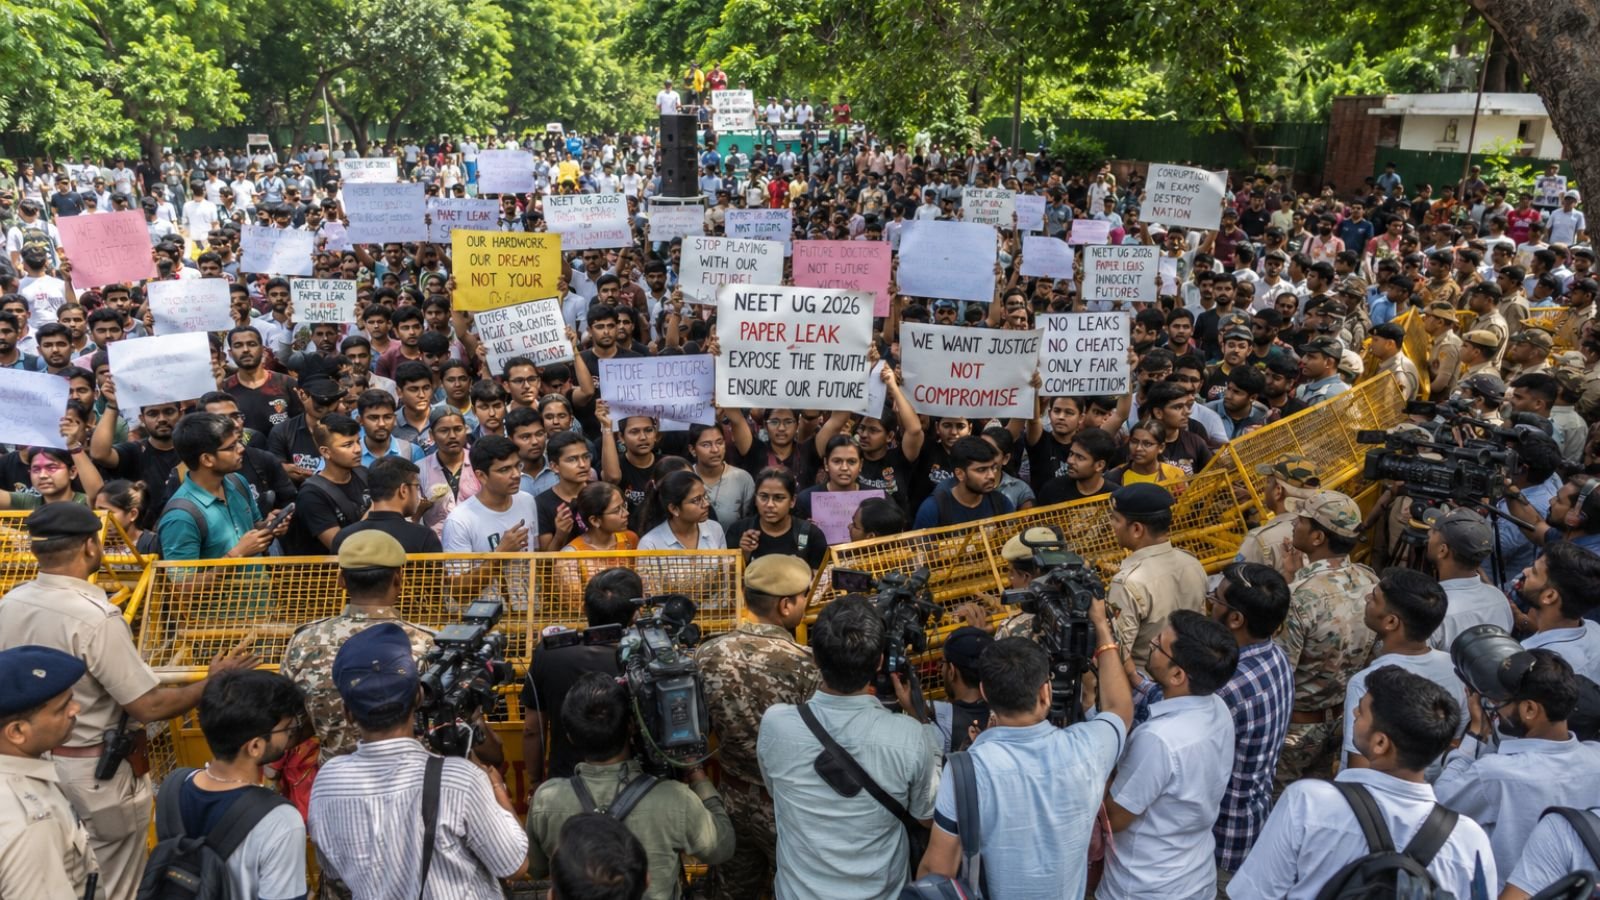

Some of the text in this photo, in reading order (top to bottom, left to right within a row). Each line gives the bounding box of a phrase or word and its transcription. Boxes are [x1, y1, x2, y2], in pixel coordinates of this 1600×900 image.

[1156, 181, 1200, 193] IN EXAMS
[550, 196, 574, 206] NEET
[596, 194, 620, 204] 2026
[1154, 193, 1193, 206] DESTROY
[1152, 207, 1192, 219] NATION
[466, 236, 487, 248] OUR
[695, 238, 768, 255] STOP PLAYING
[800, 246, 833, 258] FUTURE
[1092, 248, 1152, 258] NEET UG 2026
[470, 253, 540, 268] OUR DREAMS
[700, 254, 758, 271] WITH OUR
[808, 262, 870, 274] NOT FUTURE
[294, 280, 353, 290] NEET UG 2026
[471, 272, 544, 288] NOT YOUR
[816, 280, 859, 289] VICTIMS
[1096, 274, 1142, 285] INNOCENT
[734, 292, 860, 315] NEET UG 2026
[1048, 316, 1120, 332] NO LEAKS
[740, 321, 840, 344] PAPER LEAK
[911, 332, 1039, 354] WE WANT JUSTICE
[1048, 337, 1124, 352] NO CHEATS
[728, 350, 866, 372] EXPOSE THE TRUTH
[1048, 358, 1118, 372] ONLY FAIR
[950, 362, 985, 380] NOT
[728, 378, 866, 399] ENSURE OUR FUTURE
[914, 384, 1020, 407] COMPROMISE
